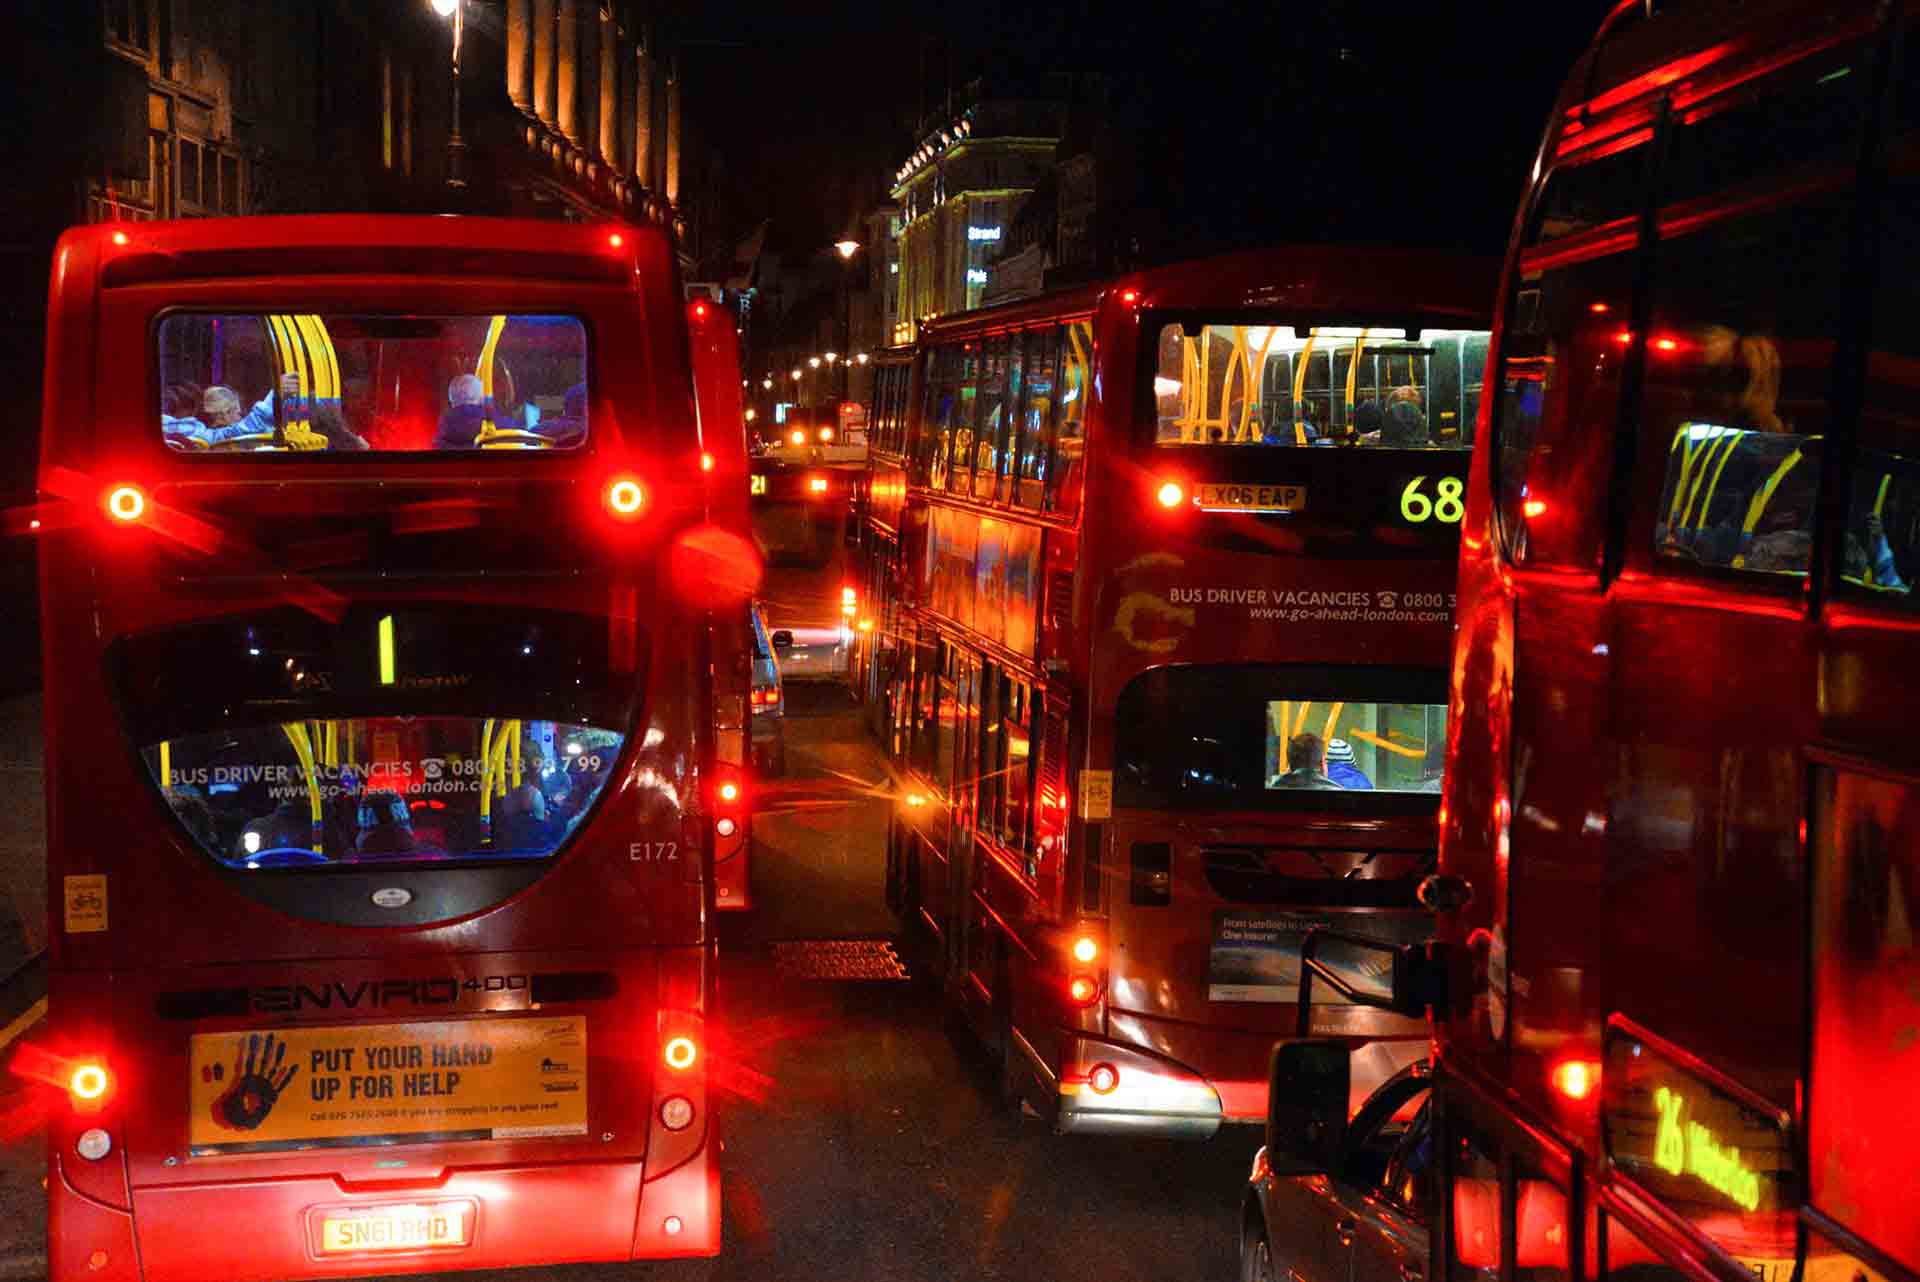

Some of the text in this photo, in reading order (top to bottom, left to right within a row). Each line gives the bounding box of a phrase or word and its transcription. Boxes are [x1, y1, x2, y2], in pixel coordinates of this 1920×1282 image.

[967, 226, 1001, 240] Strand
[1257, 486, 1297, 507] EAP
[1400, 476, 1465, 523] 68
[1169, 588, 1202, 603] BUS
[1207, 589, 1267, 604] DRIVER
[1272, 590, 1371, 607] VACANCIES
[1403, 592, 1443, 608] 0800
[1250, 606, 1449, 623] www.go-ahead-london.com
[169, 767, 208, 784] BUS
[214, 765, 288, 784] DRIVER
[296, 761, 412, 782] VACANCIES
[452, 759, 488, 776] 080
[630, 842, 678, 860] E172
[463, 975, 527, 992] 400
[310, 1043, 493, 1073] PUT YOUR HAND
[310, 1070, 461, 1102] UP FOR HELP
